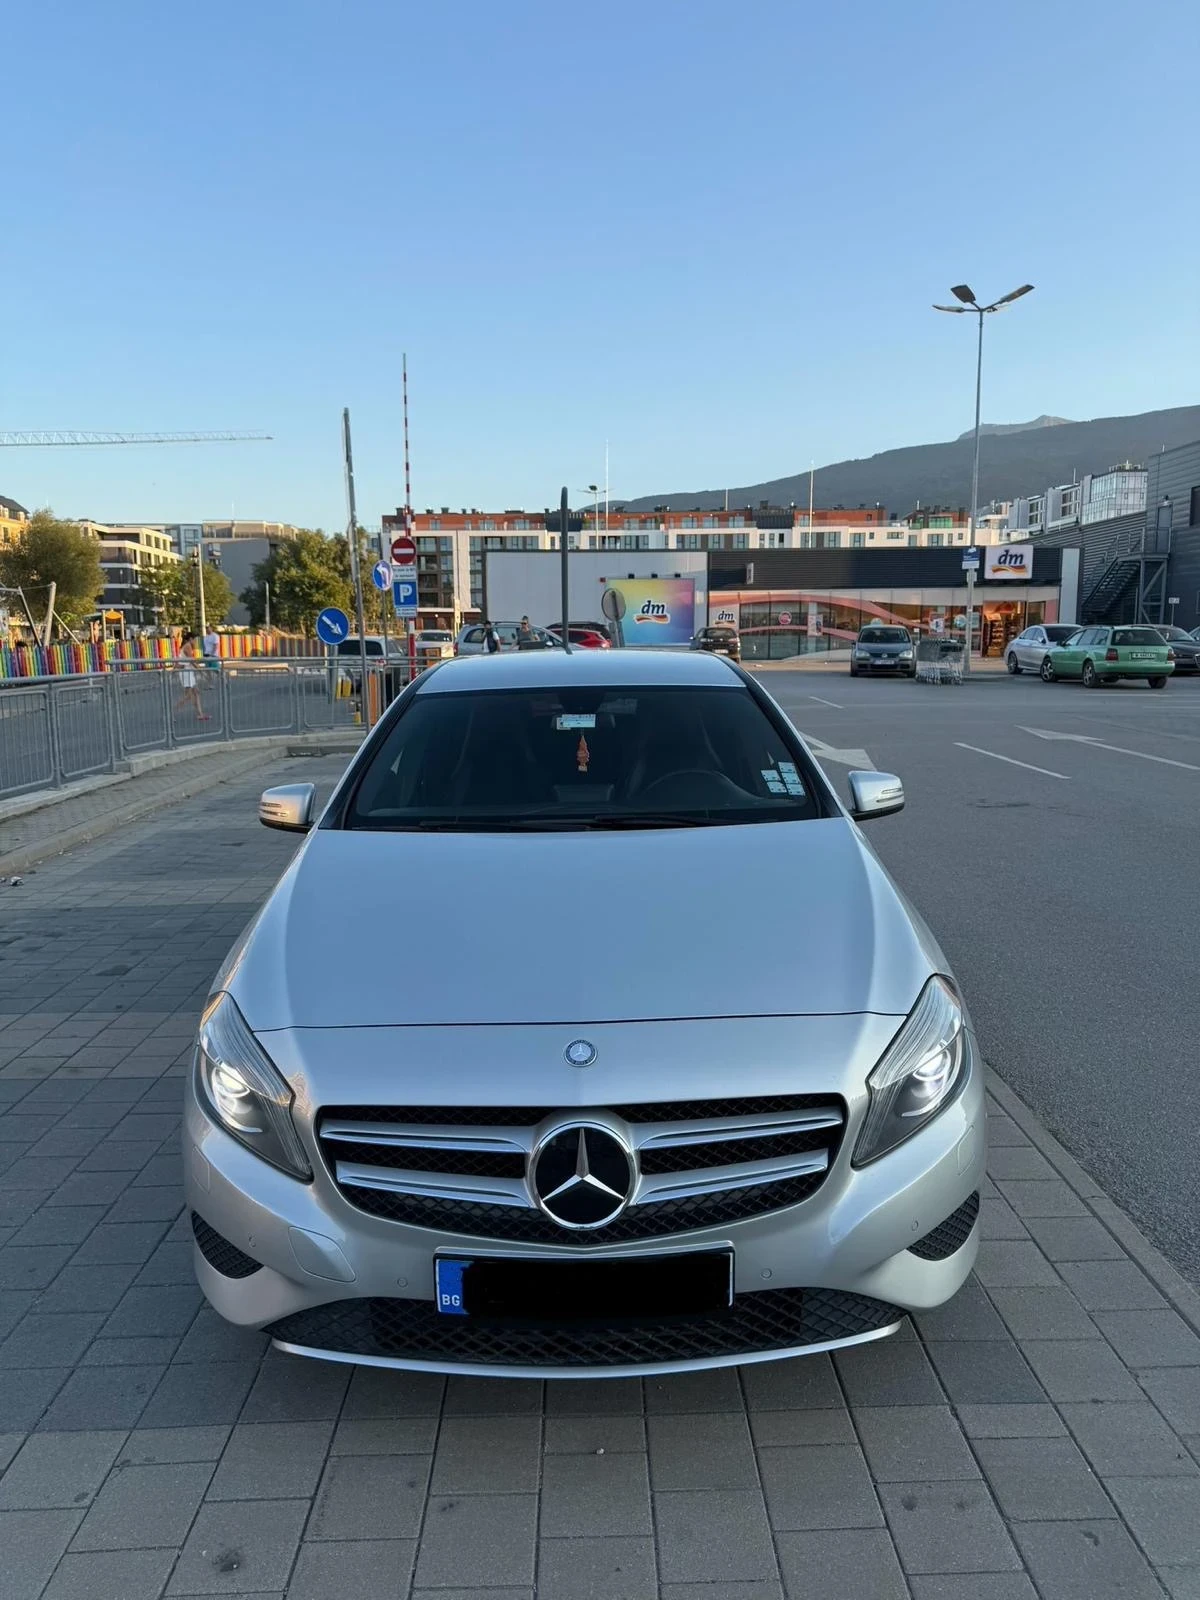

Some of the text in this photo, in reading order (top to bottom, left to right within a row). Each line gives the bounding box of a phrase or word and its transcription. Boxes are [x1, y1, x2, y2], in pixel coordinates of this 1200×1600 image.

[998, 550, 1024, 565] dm
[400, 584, 413, 604] P
[641, 600, 665, 614] dm
[718, 611, 734, 620] dm
[442, 1294, 460, 1307] BG
